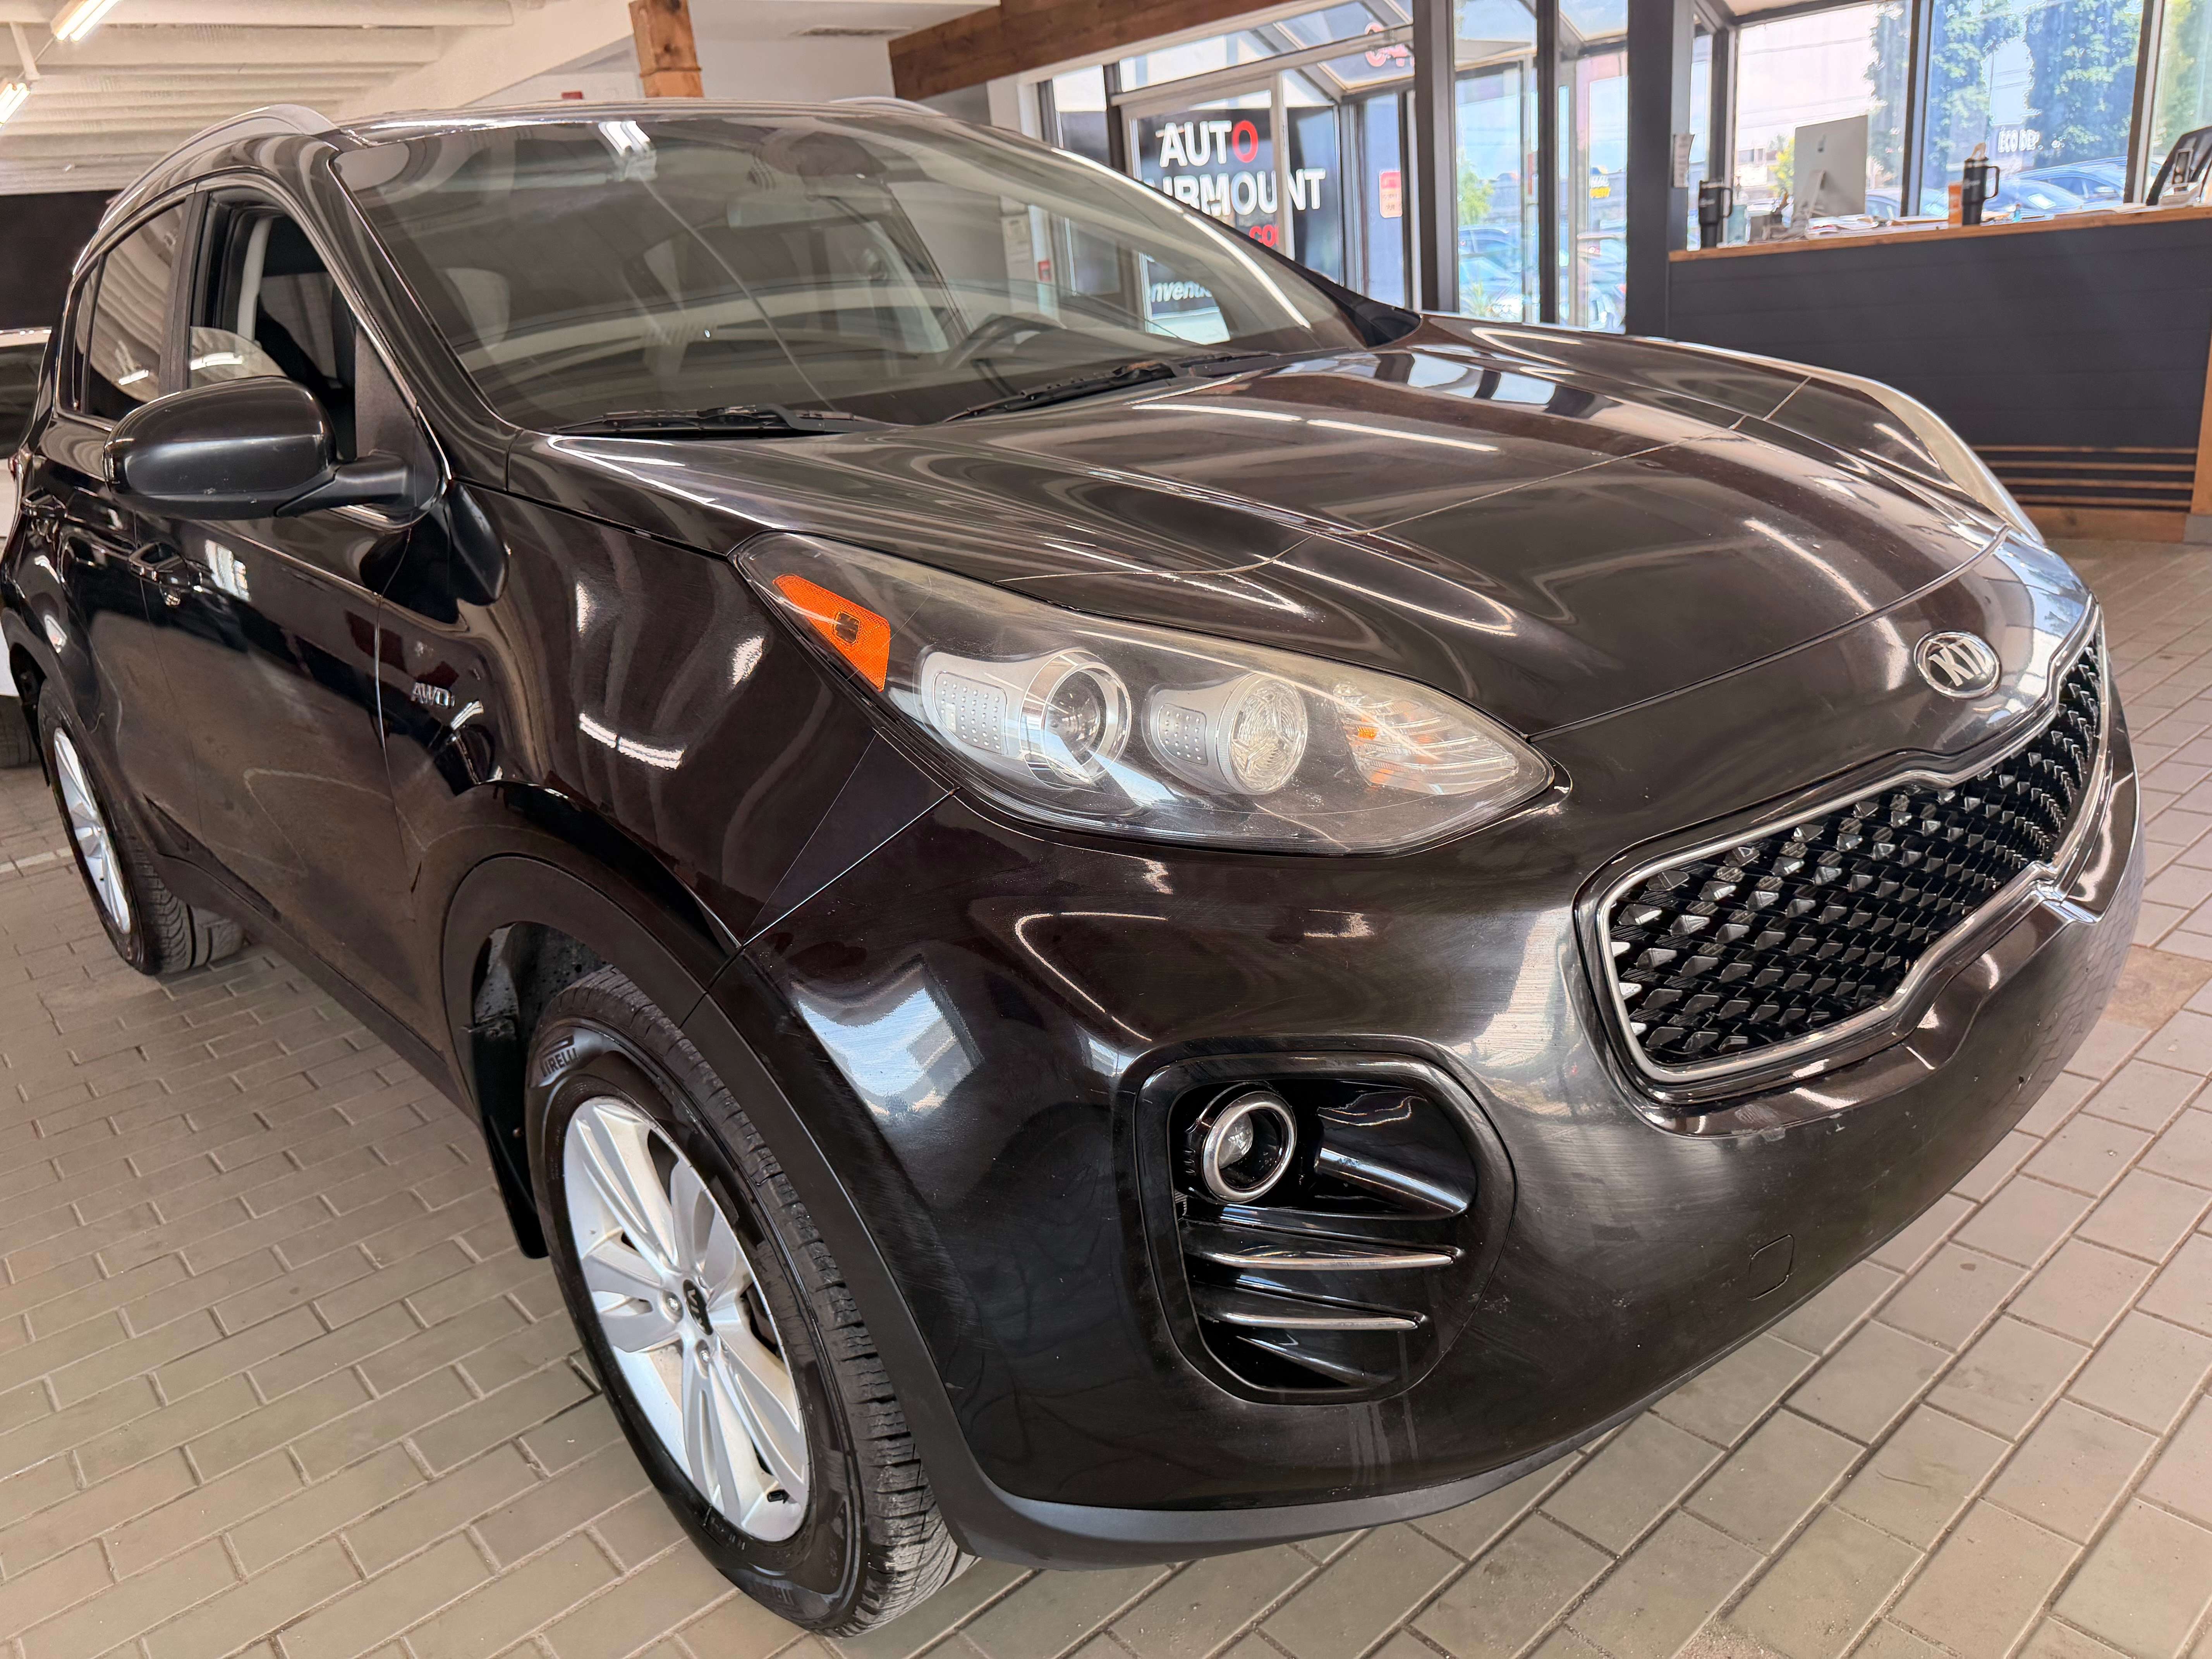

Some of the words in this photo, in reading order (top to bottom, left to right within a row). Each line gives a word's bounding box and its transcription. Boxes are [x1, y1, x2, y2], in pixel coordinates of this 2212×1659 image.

[1159, 120, 1258, 167] AUTO
[1144, 168, 1326, 216] RMOUNT
[1928, 638, 1995, 687] KIA
